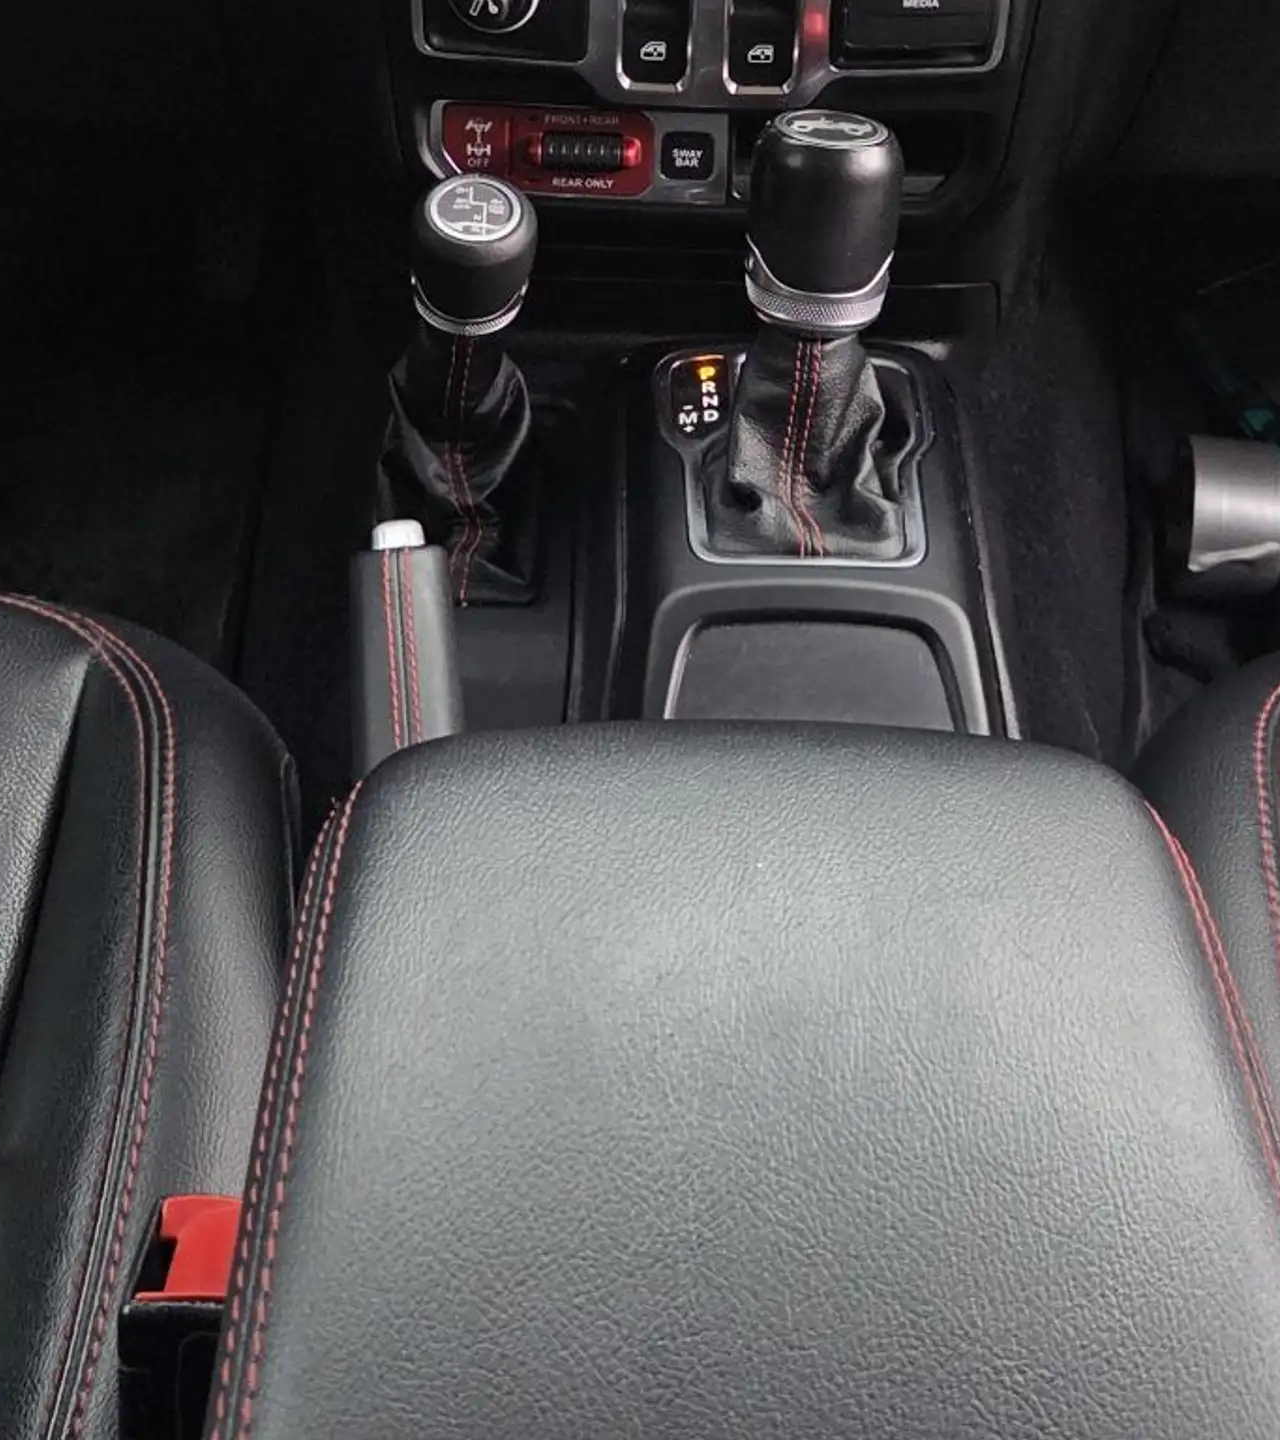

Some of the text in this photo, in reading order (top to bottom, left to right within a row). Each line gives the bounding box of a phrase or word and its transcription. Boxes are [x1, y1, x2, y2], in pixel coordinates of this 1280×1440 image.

[672, 148, 703, 159] SWAY
[675, 157, 699, 168] BAR
[552, 177, 613, 190] REAR ONLY
[700, 366, 716, 380] P
[702, 381, 716, 393] R
[702, 394, 718, 408] N
[679, 411, 698, 425] M
[703, 409, 719, 422] D
